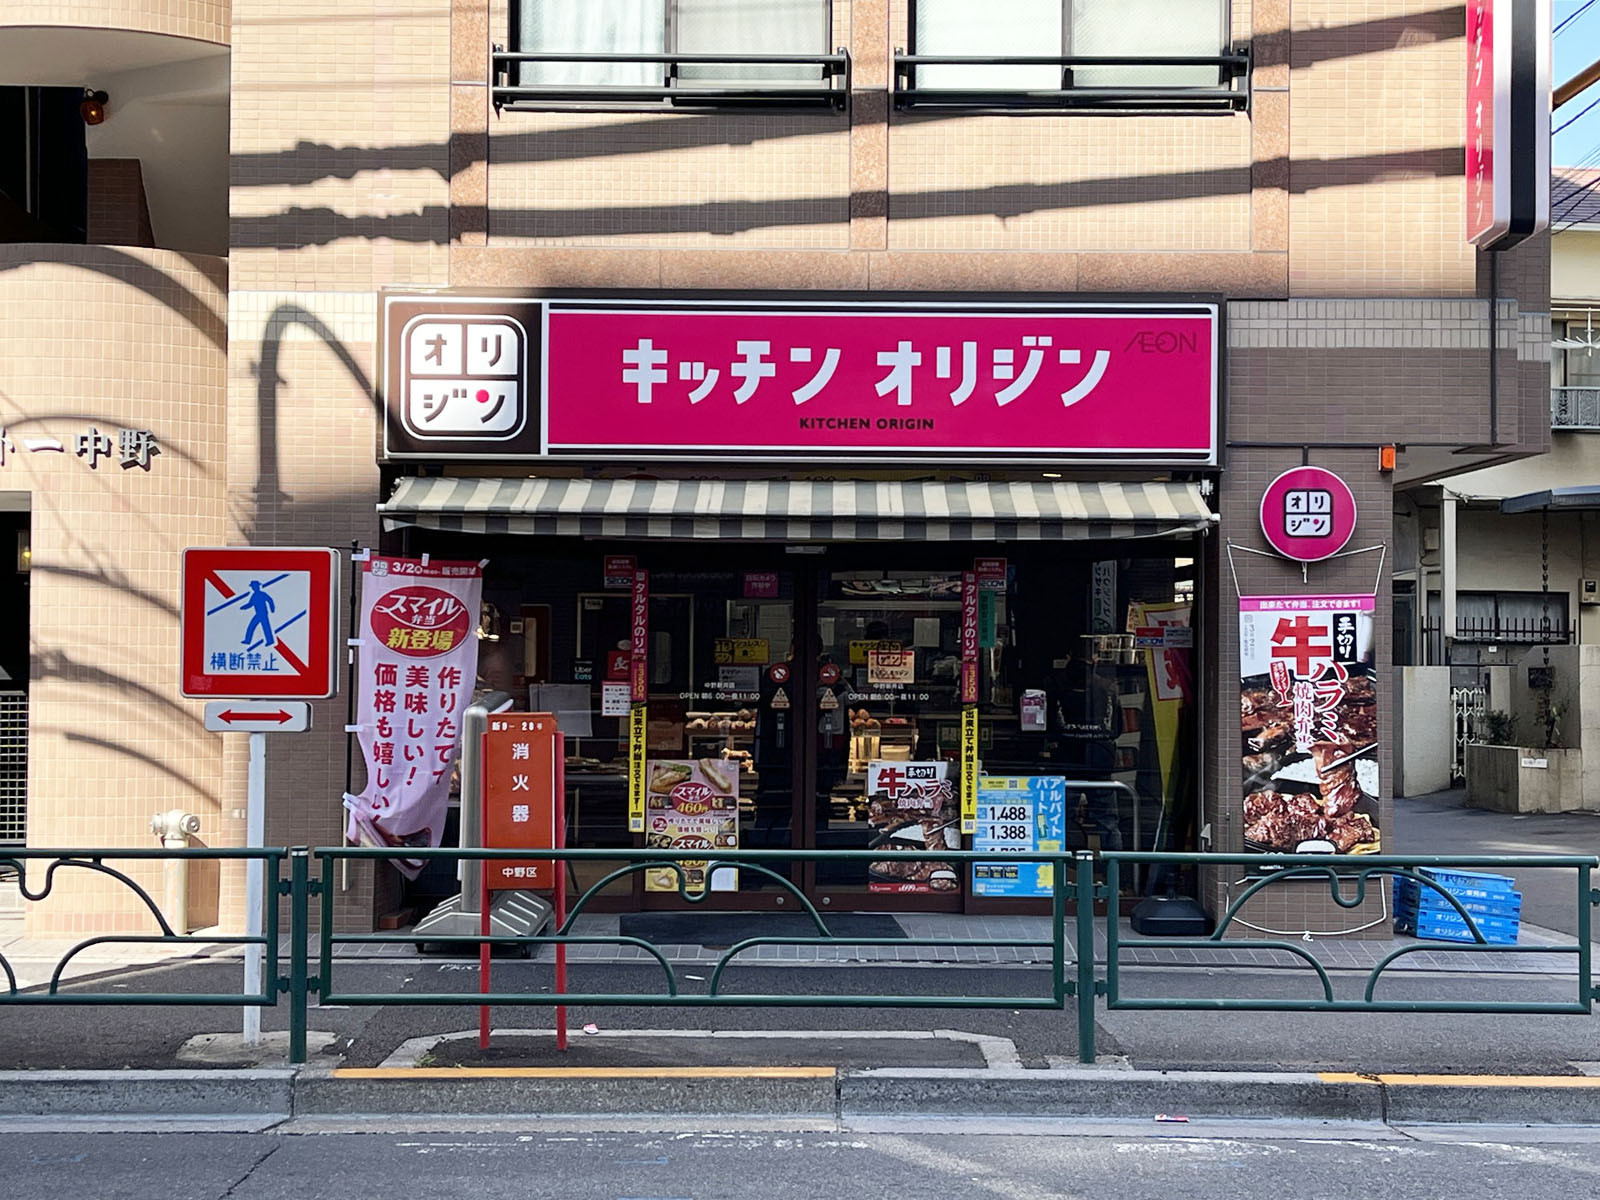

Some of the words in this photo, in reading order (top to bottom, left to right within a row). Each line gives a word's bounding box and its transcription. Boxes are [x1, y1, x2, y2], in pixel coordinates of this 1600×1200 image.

[622, 338, 842, 406] キッチン
[874, 335, 1111, 407] オリジン
[800, 417, 871, 431] KITCHEN
[876, 417, 935, 431] ORIGIN
[387, 594, 461, 616] スマイル
[386, 627, 455, 651] 新登場
[1336, 616, 1356, 659] 手切り
[210, 652, 280, 672] 横断禁止
[679, 692, 700, 700] OPEN
[848, 693, 869, 701] OPEN
[511, 743, 530, 823] 消火器
[1036, 777, 1049, 815] パート
[1049, 778, 1063, 837] アルバイト
[502, 866, 538, 878] 中野区
